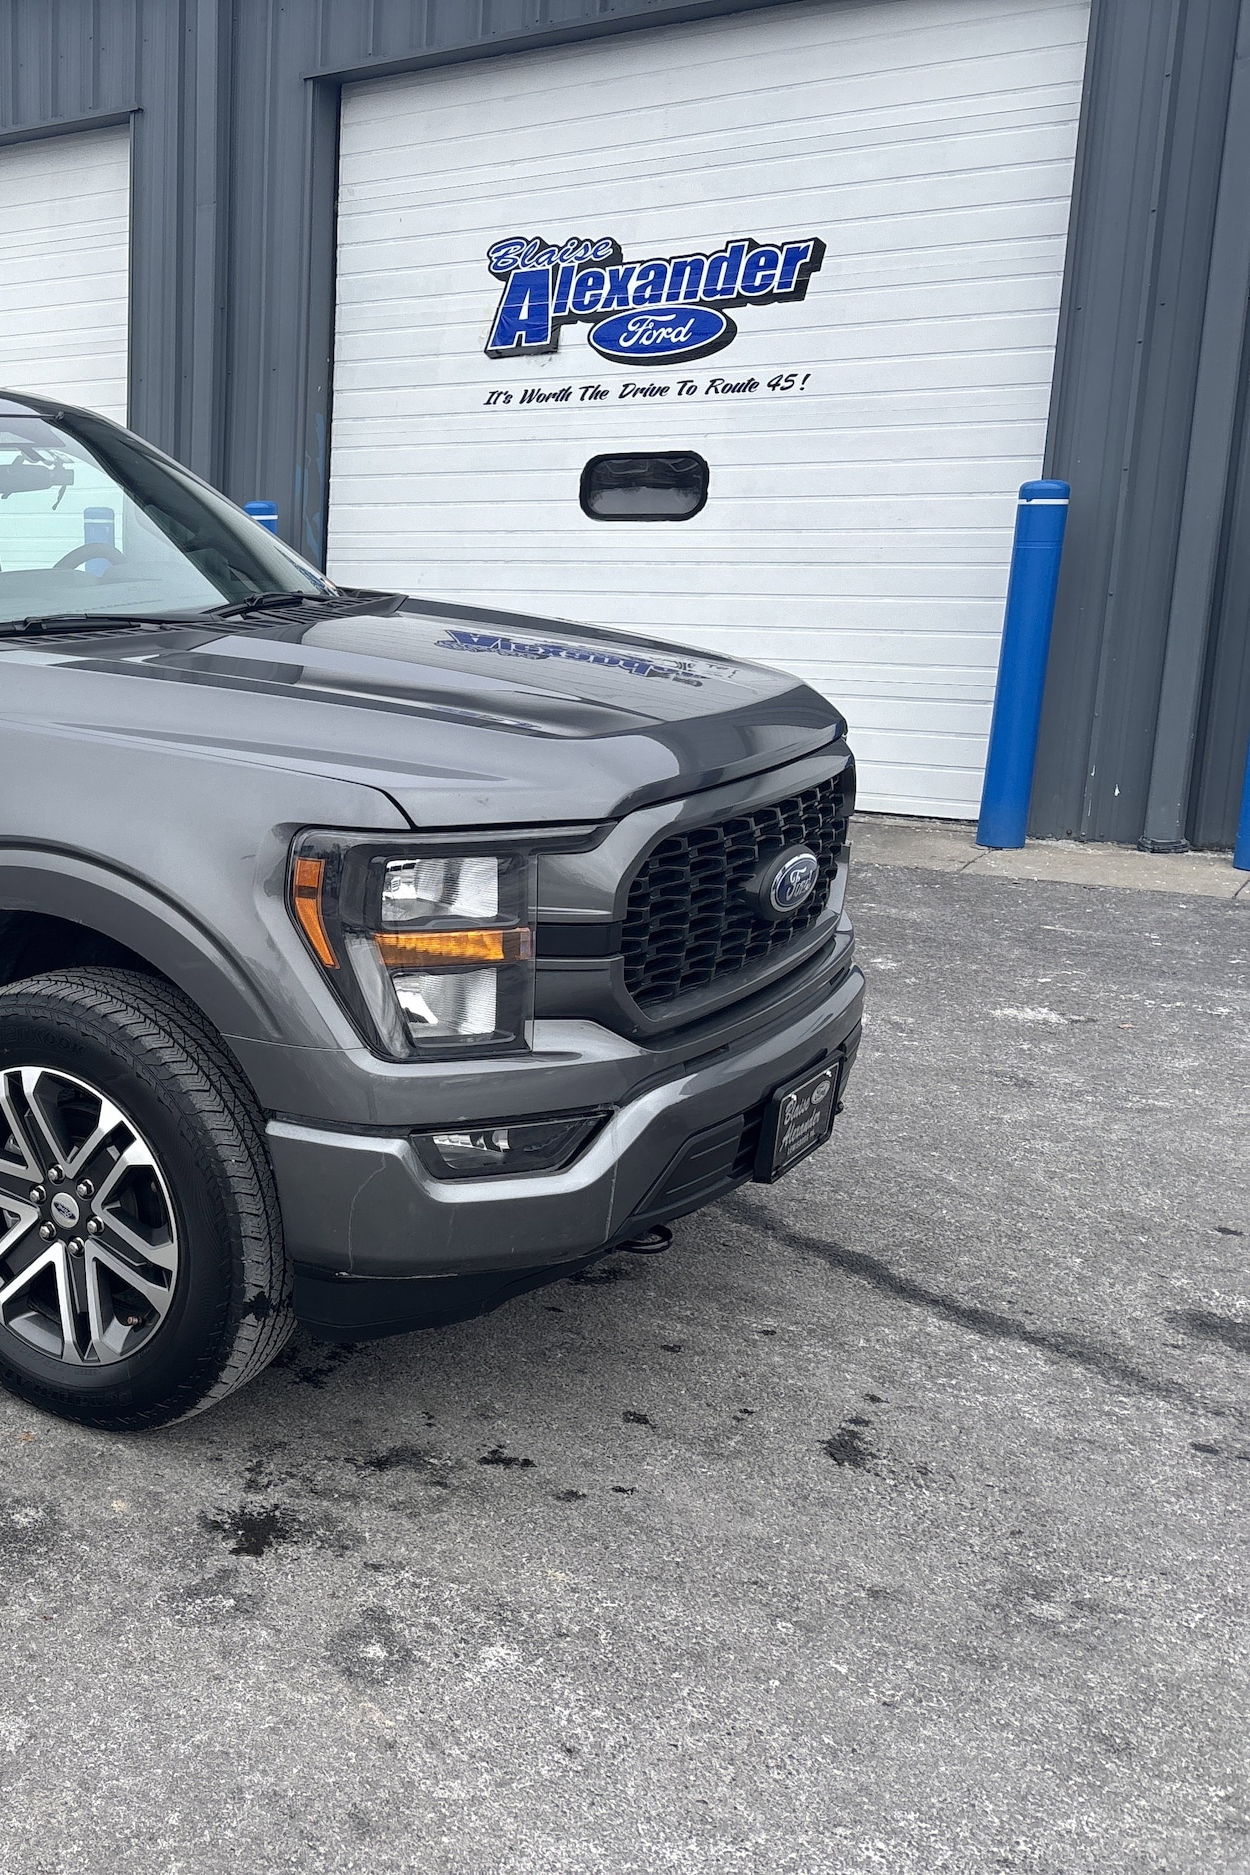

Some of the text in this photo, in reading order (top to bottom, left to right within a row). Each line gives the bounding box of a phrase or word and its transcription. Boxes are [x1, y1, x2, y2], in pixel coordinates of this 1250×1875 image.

[491, 238, 613, 272] Blaise
[488, 240, 815, 350] Alexander
[618, 314, 694, 347] Ford
[483, 390, 513, 405] It's
[519, 386, 572, 404] Worth
[579, 384, 610, 401] The
[618, 382, 670, 398] Drive
[677, 379, 698, 396] To
[704, 377, 760, 395] Route
[786, 866, 813, 901] Ford
